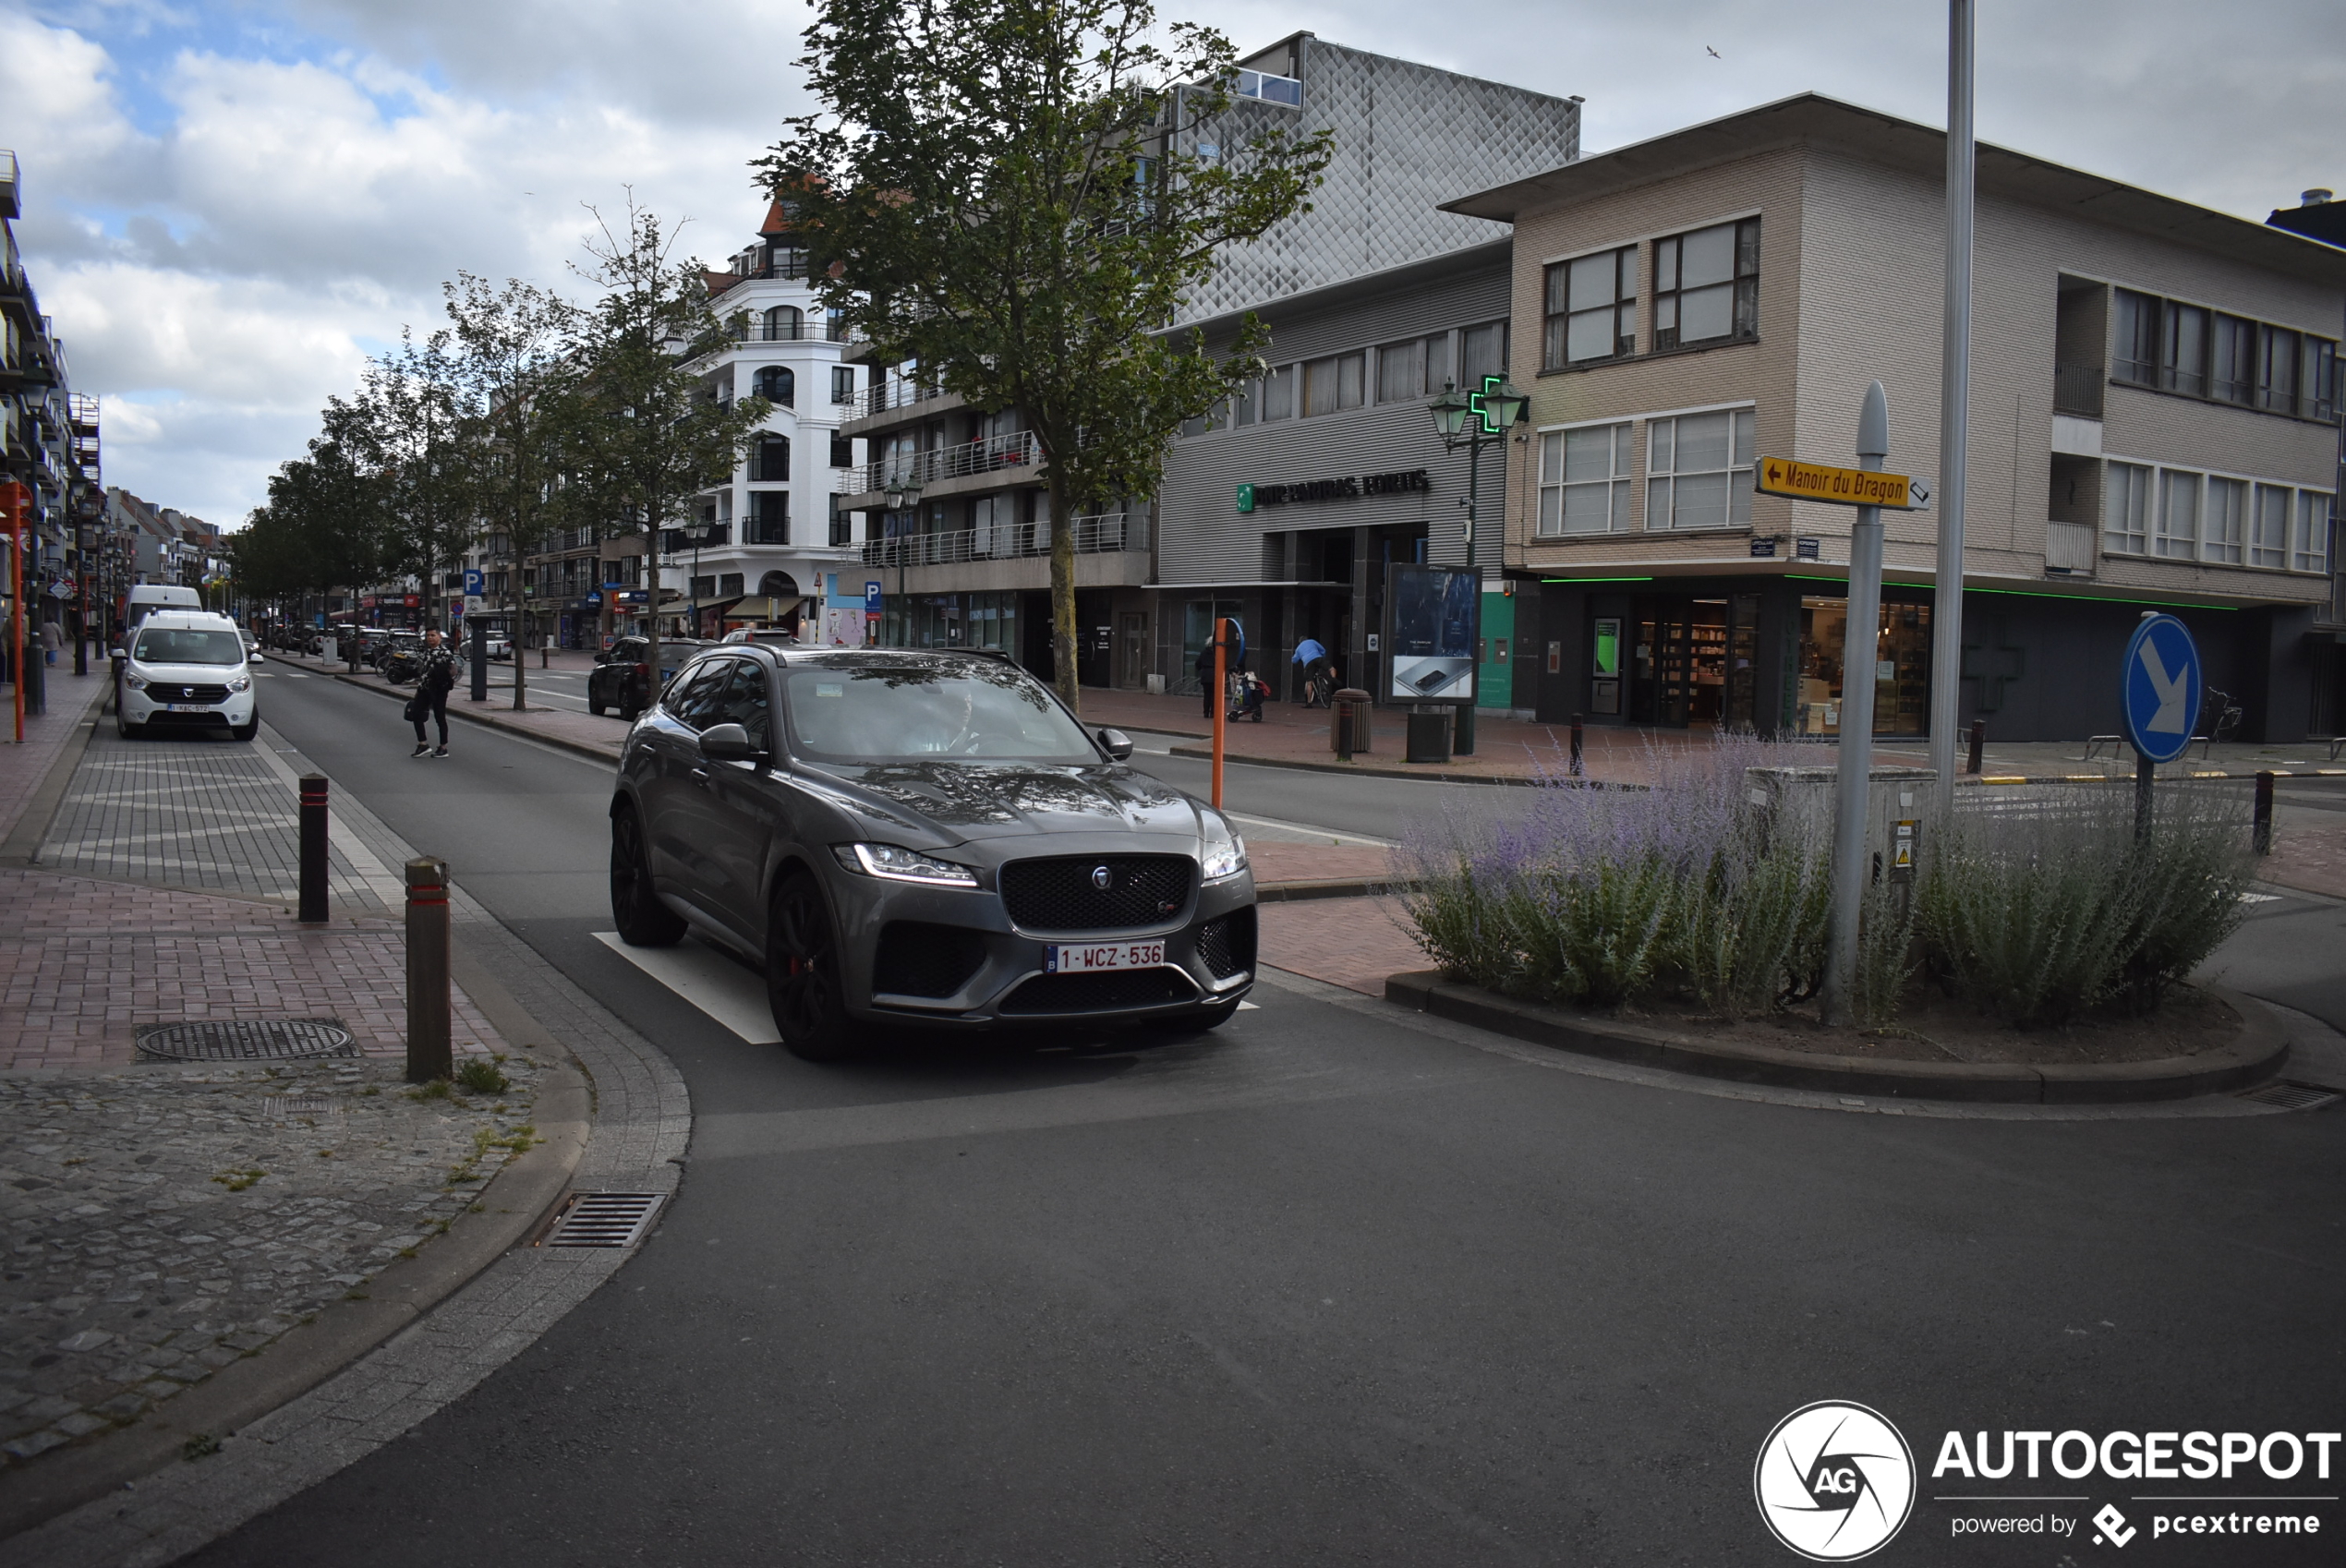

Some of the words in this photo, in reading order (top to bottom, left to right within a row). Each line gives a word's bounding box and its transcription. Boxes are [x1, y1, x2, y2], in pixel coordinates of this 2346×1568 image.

[1253, 486, 1287, 505] BNP
[1287, 476, 1358, 502] PARIBAS
[1361, 469, 1430, 496] FORTIS
[1785, 463, 1830, 491] Manoir
[1833, 470, 1850, 494] du
[1854, 473, 1903, 503] Dragon
[466, 573, 479, 592] P
[867, 585, 879, 601] P
[1047, 960, 1056, 970] B
[1061, 945, 1161, 969] 1-WCZ-536
